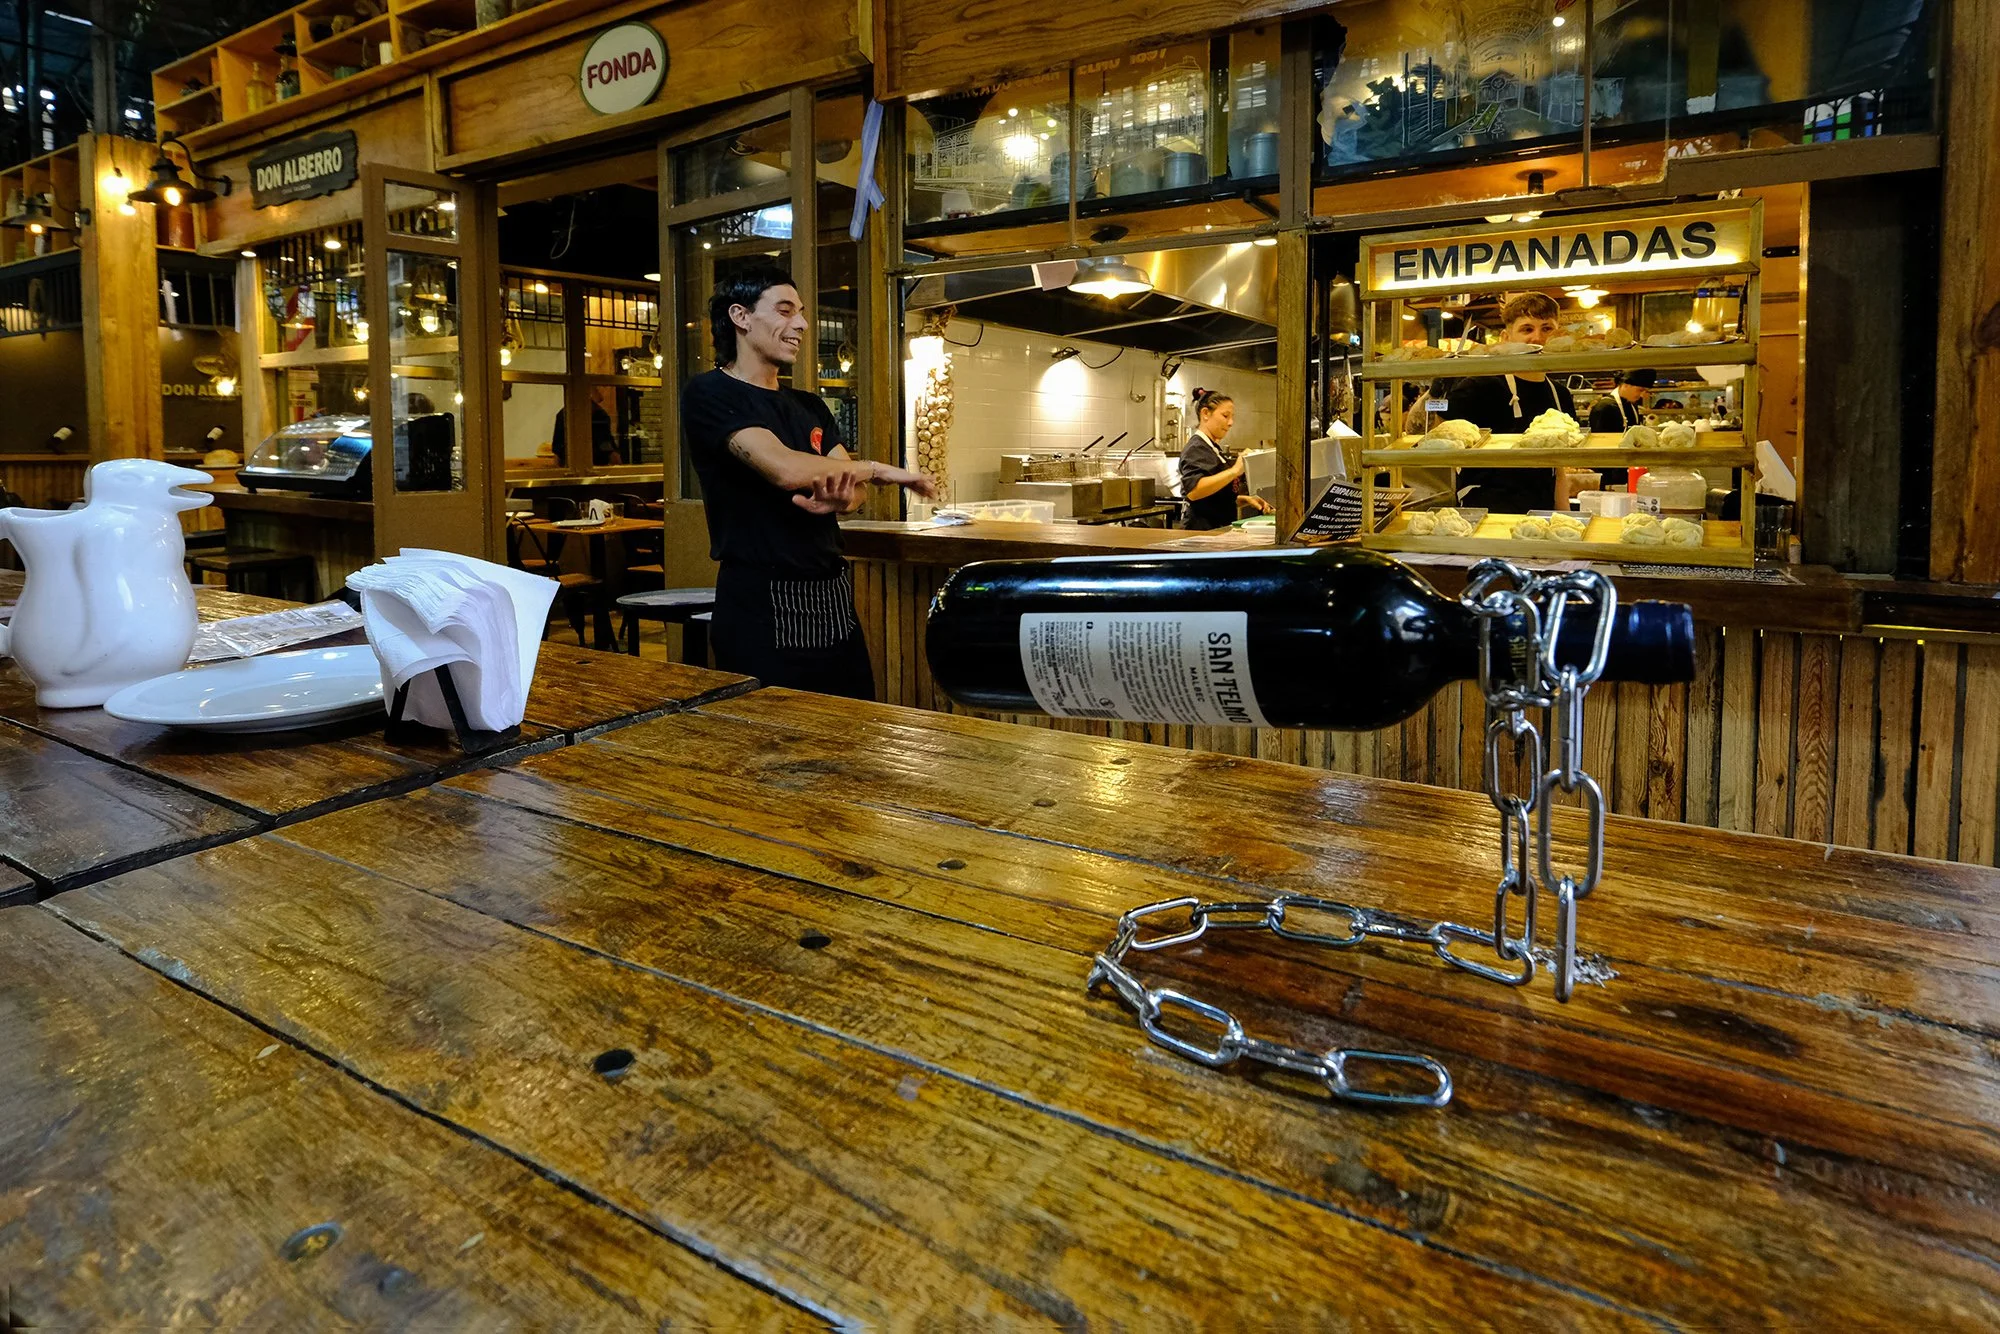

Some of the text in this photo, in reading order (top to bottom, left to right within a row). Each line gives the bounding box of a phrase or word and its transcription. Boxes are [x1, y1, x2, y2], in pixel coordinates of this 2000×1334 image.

[586, 47, 657, 89] FONDA
[256, 146, 342, 192] DON ALBERRO
[1393, 220, 1717, 283] EMPANADAS
[162, 384, 196, 396] DON
[1189, 666, 1205, 702] MALBEC
[1208, 631, 1253, 723] SAN TELMO
